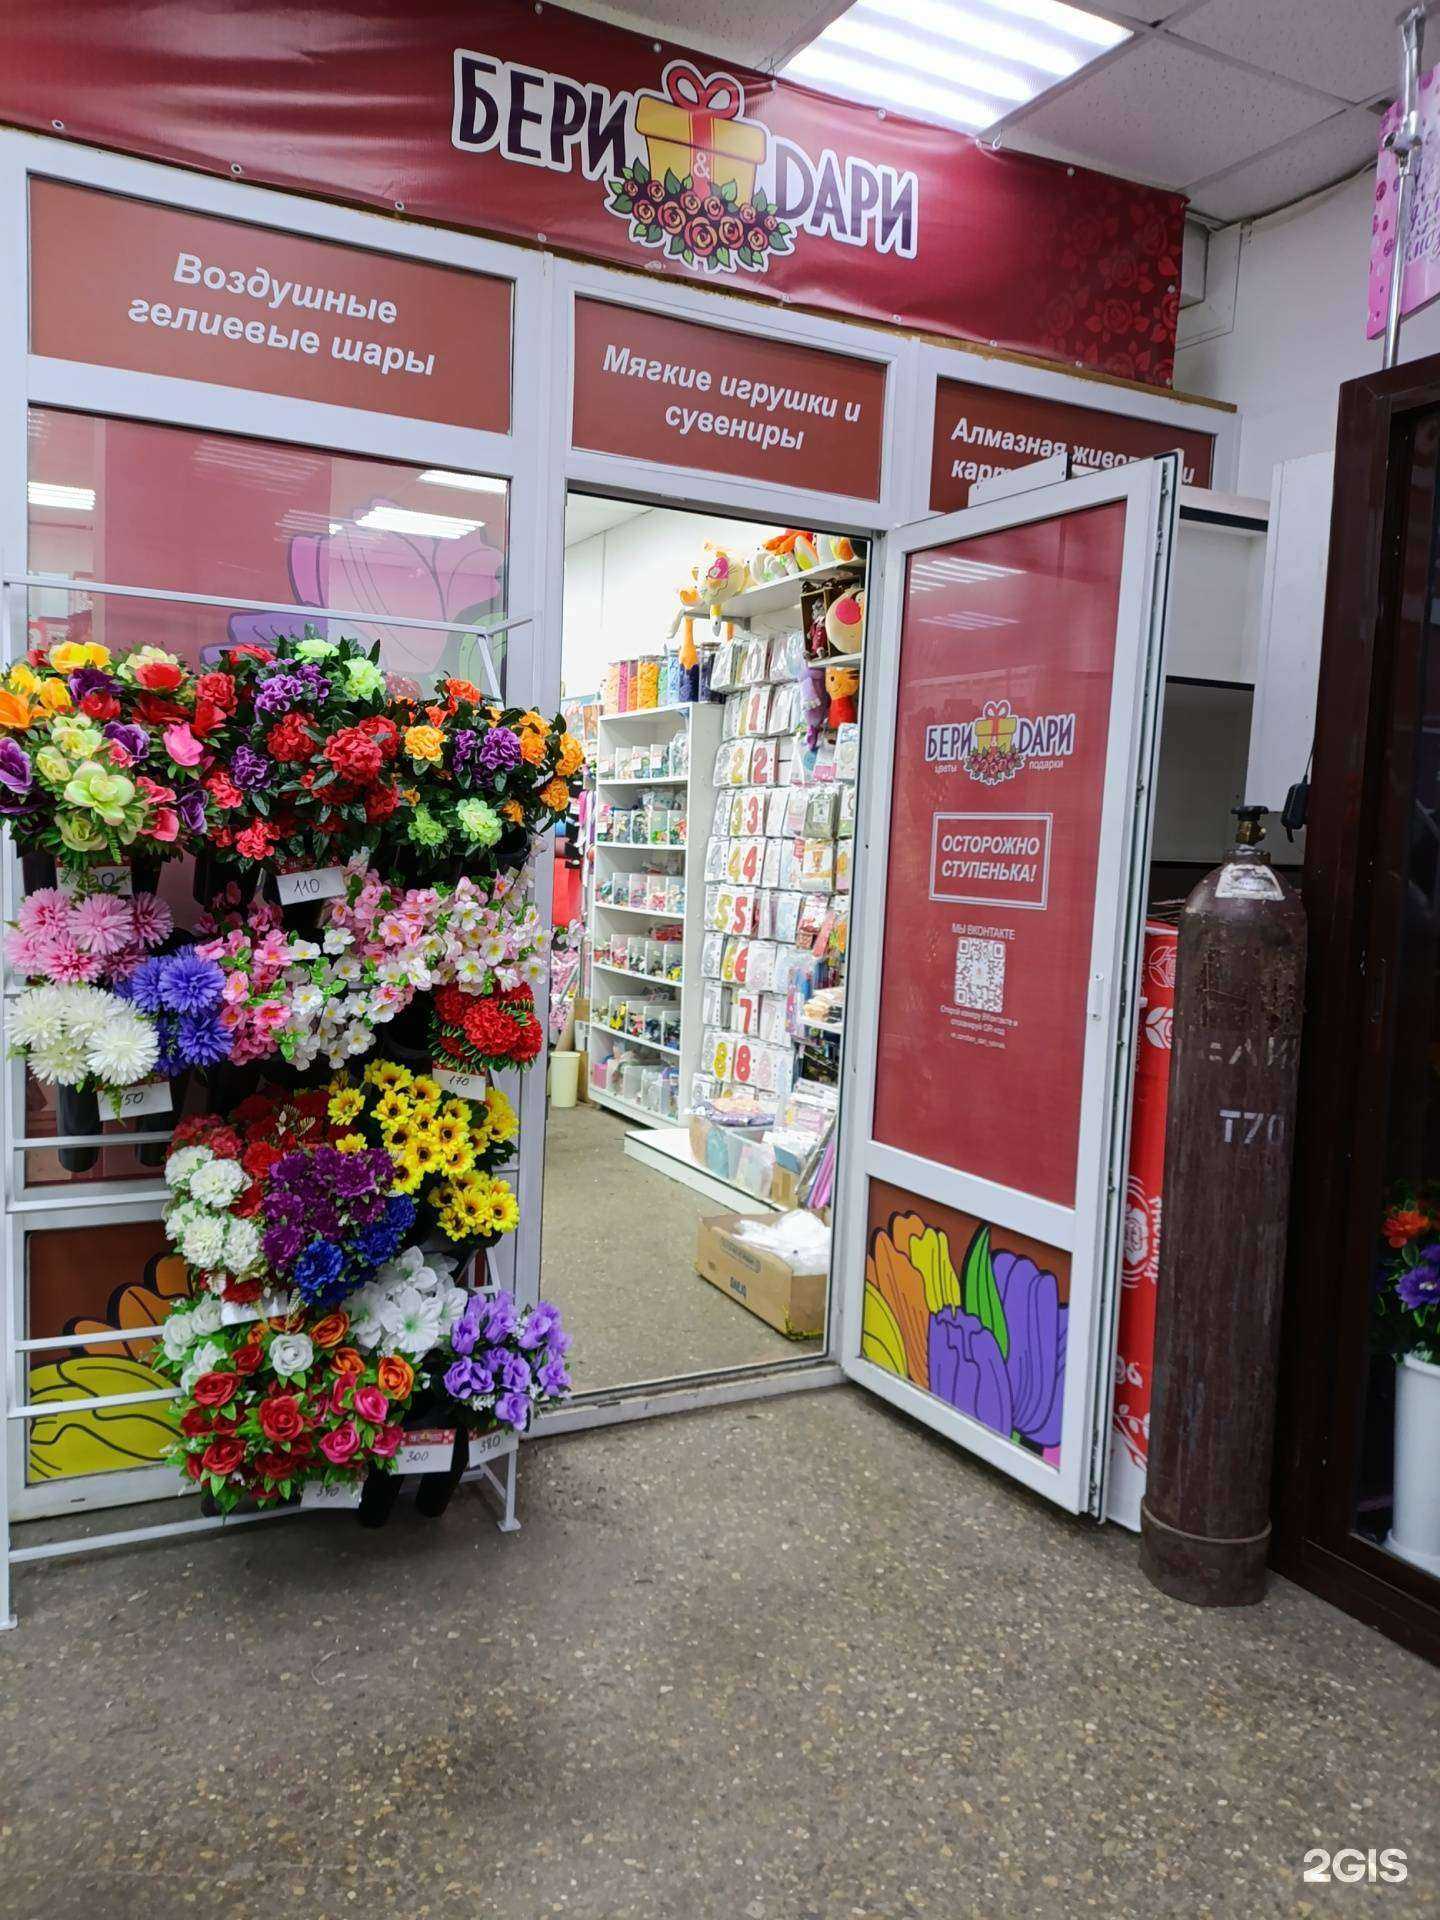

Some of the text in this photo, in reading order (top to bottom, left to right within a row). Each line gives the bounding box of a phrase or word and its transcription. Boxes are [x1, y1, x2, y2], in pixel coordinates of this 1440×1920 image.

[454, 51, 632, 180] БЕРИ
[173, 252, 398, 324] Воздушные
[128, 299, 436, 376] гелиевые шары
[602, 344, 862, 422] Мягкие игрушки и
[665, 406, 804, 450] сувениры
[950, 417, 1067, 456] Алмазная
[927, 722, 974, 758] БЕРИ
[941, 834, 1040, 856] ОСТОРОЖНО
[294, 878, 320, 897] 110
[941, 859, 1038, 882] СТУПЕНЬКА!
[951, 922, 1016, 941] МЫ ВКОНТАКТЕ
[406, 1450, 430, 1463] 300
